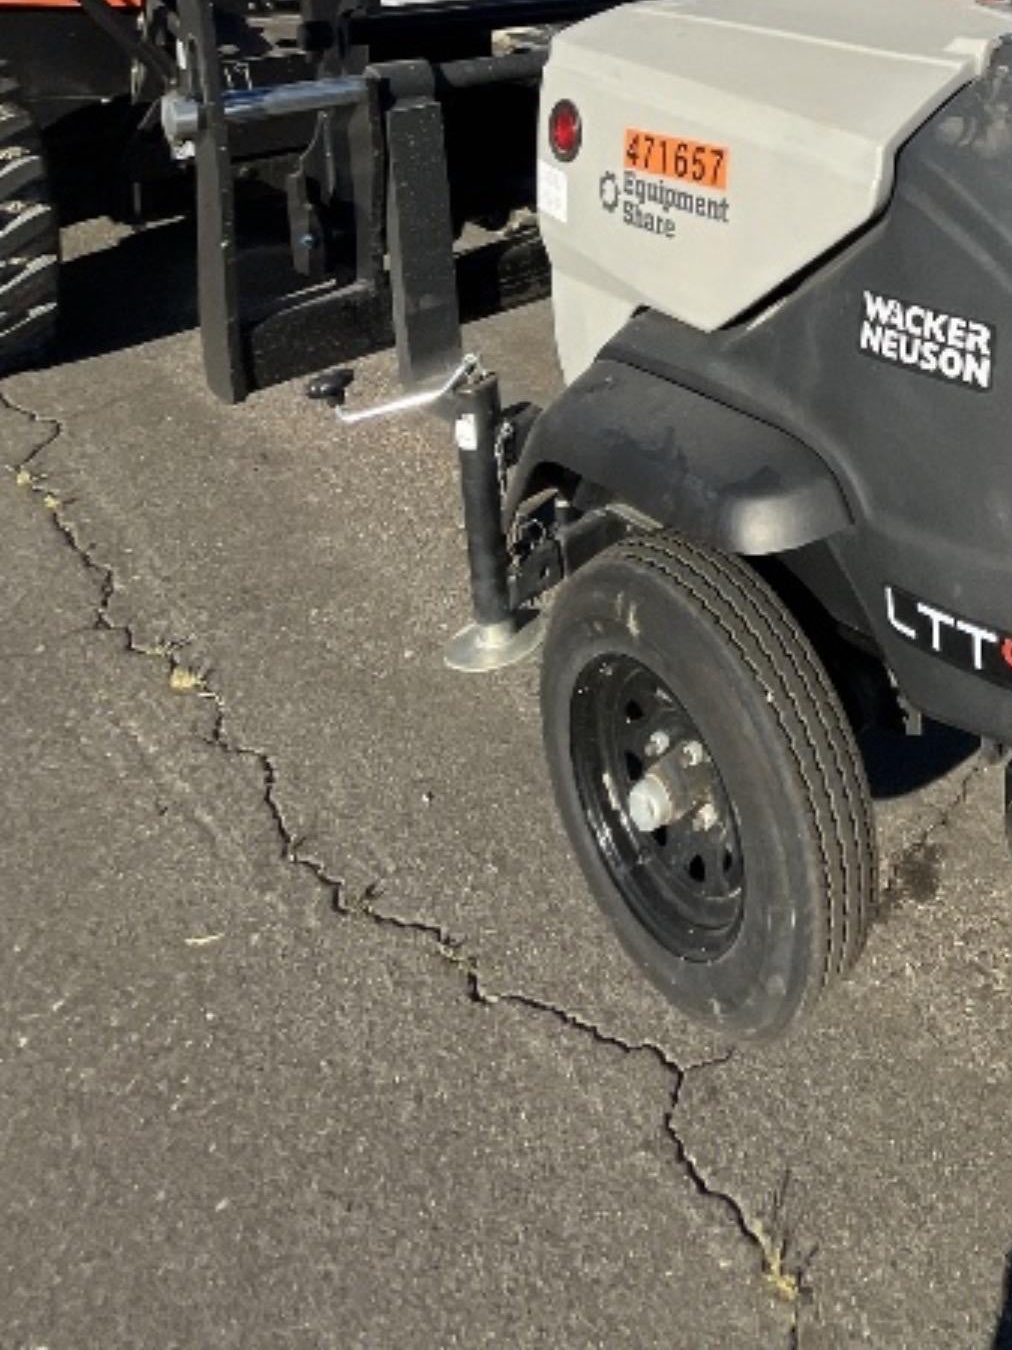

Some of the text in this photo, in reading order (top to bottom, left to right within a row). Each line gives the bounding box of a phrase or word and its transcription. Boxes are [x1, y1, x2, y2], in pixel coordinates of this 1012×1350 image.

[625, 133, 725, 186] 471657
[623, 170, 730, 223] Equipment
[623, 200, 676, 238] Share
[862, 289, 992, 357] WACKER
[859, 319, 992, 389] NEUSON
